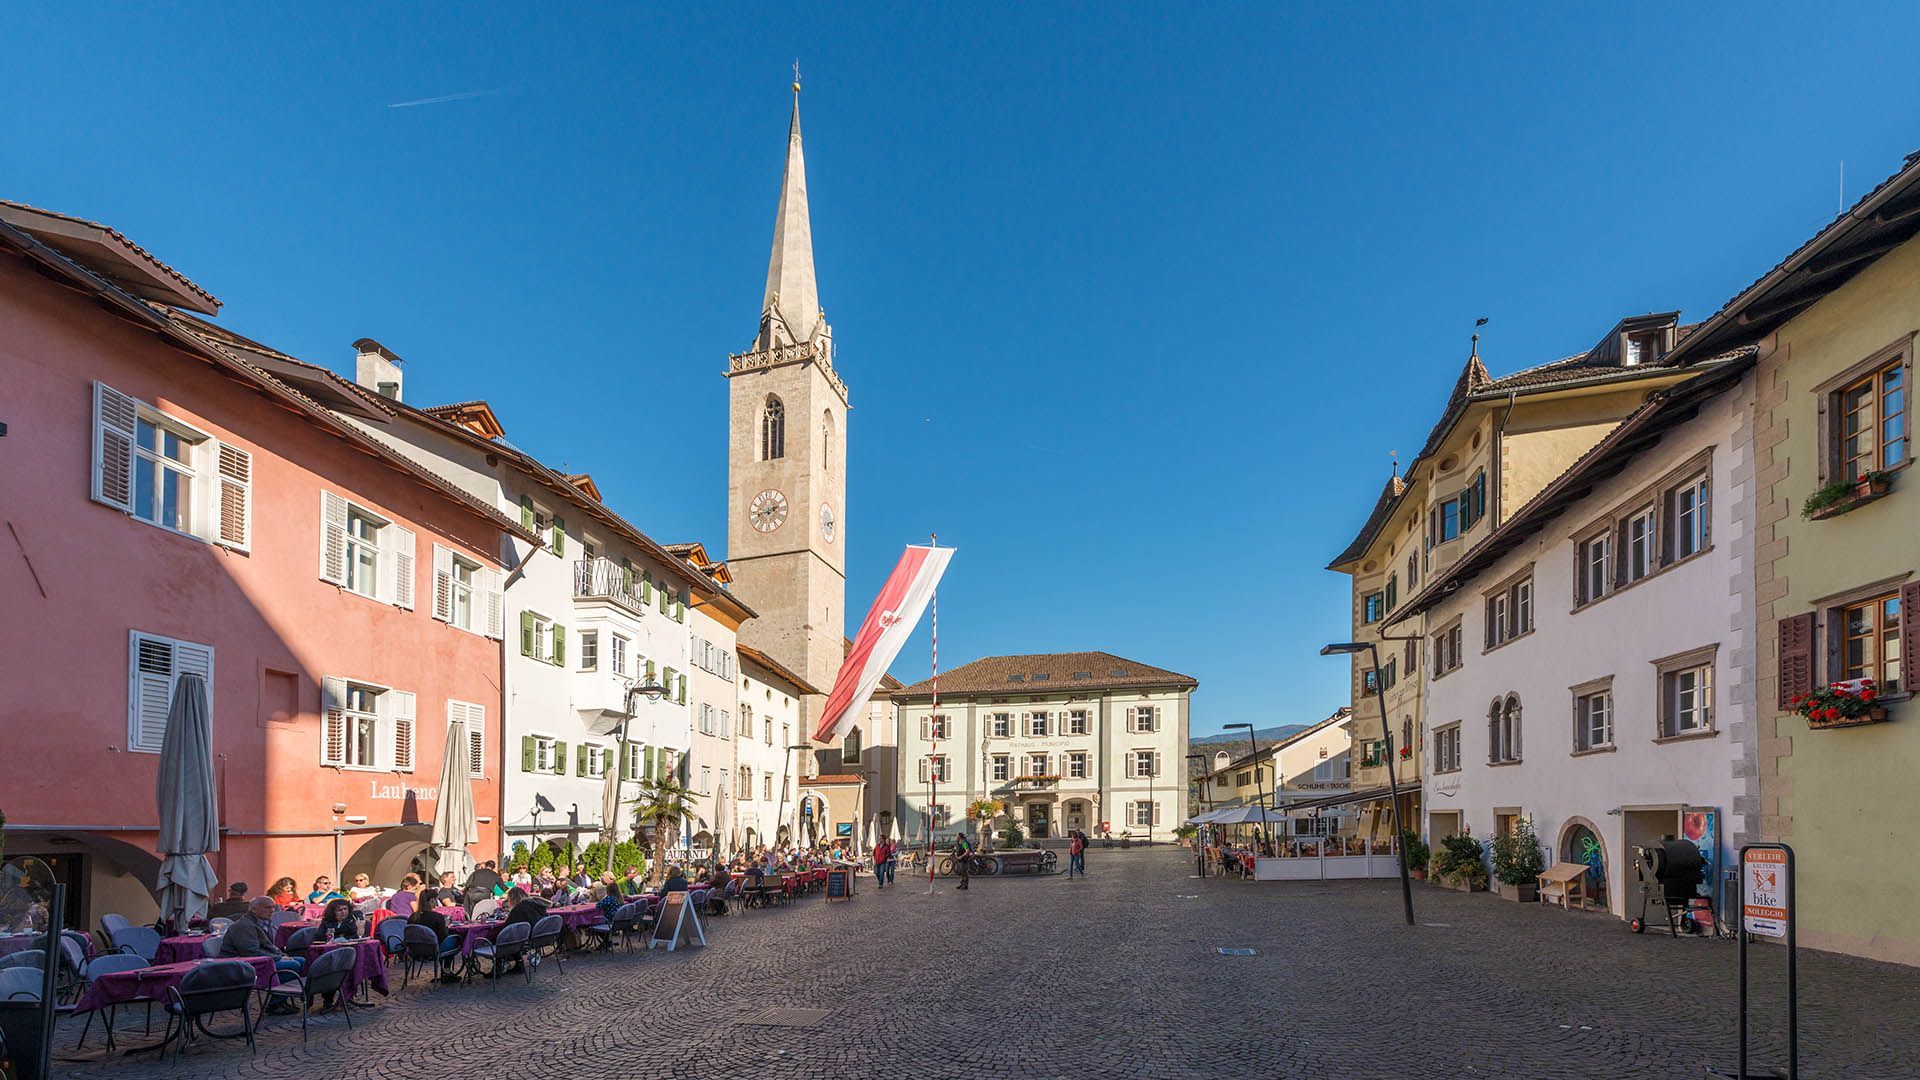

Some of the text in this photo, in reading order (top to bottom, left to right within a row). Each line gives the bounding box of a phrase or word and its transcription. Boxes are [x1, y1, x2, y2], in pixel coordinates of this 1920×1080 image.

[1297, 782, 1324, 790] SCHUHE
[1748, 852, 1781, 861] VERLEIH
[1753, 892, 1776, 906] bike
[1746, 908, 1783, 918] NOLEGGIO
